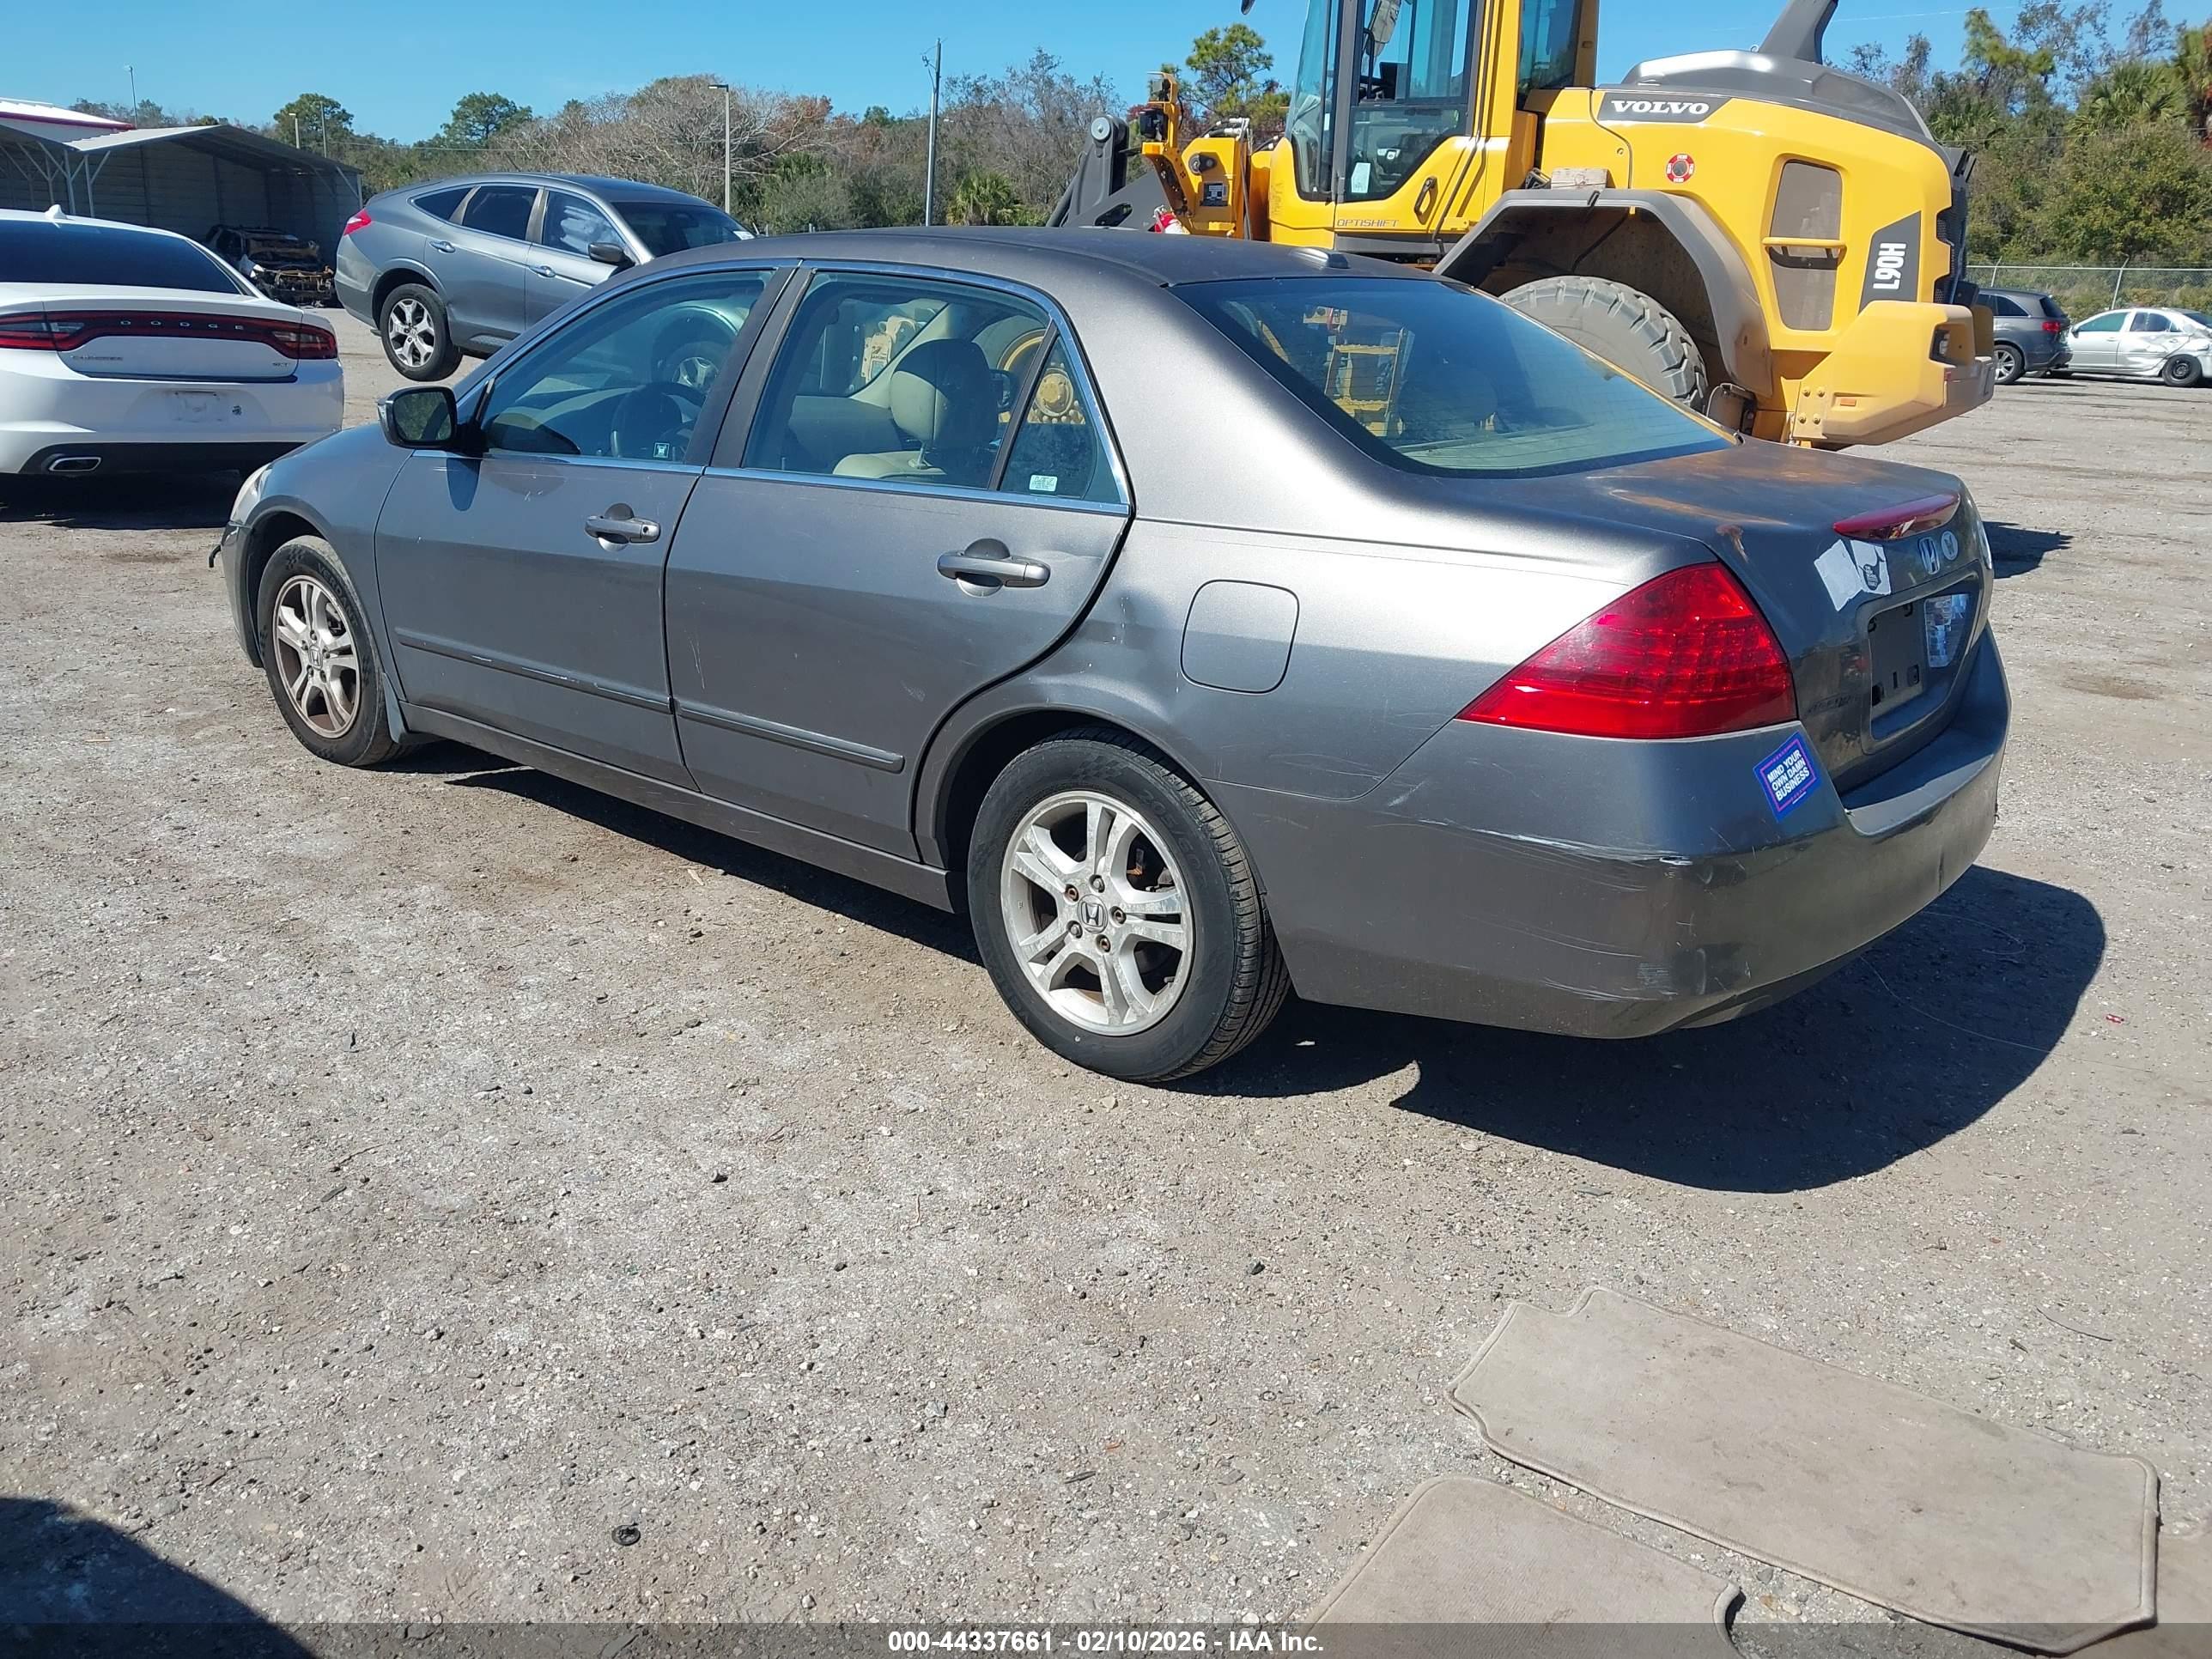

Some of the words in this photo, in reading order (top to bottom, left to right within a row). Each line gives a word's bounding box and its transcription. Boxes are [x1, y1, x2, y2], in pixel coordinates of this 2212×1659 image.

[1611, 100, 1710, 114] VOLVO
[1337, 218, 1400, 228] OPTISHIFT
[1873, 243, 1906, 289] L90H
[120, 320, 244, 331] DODGE
[1767, 764, 1785, 783] MIND
[1783, 750, 1802, 769] YOUR
[1771, 773, 1788, 791] OWN
[1786, 757, 1806, 778] DAMN
[1775, 767, 1809, 801] BUSINESS
